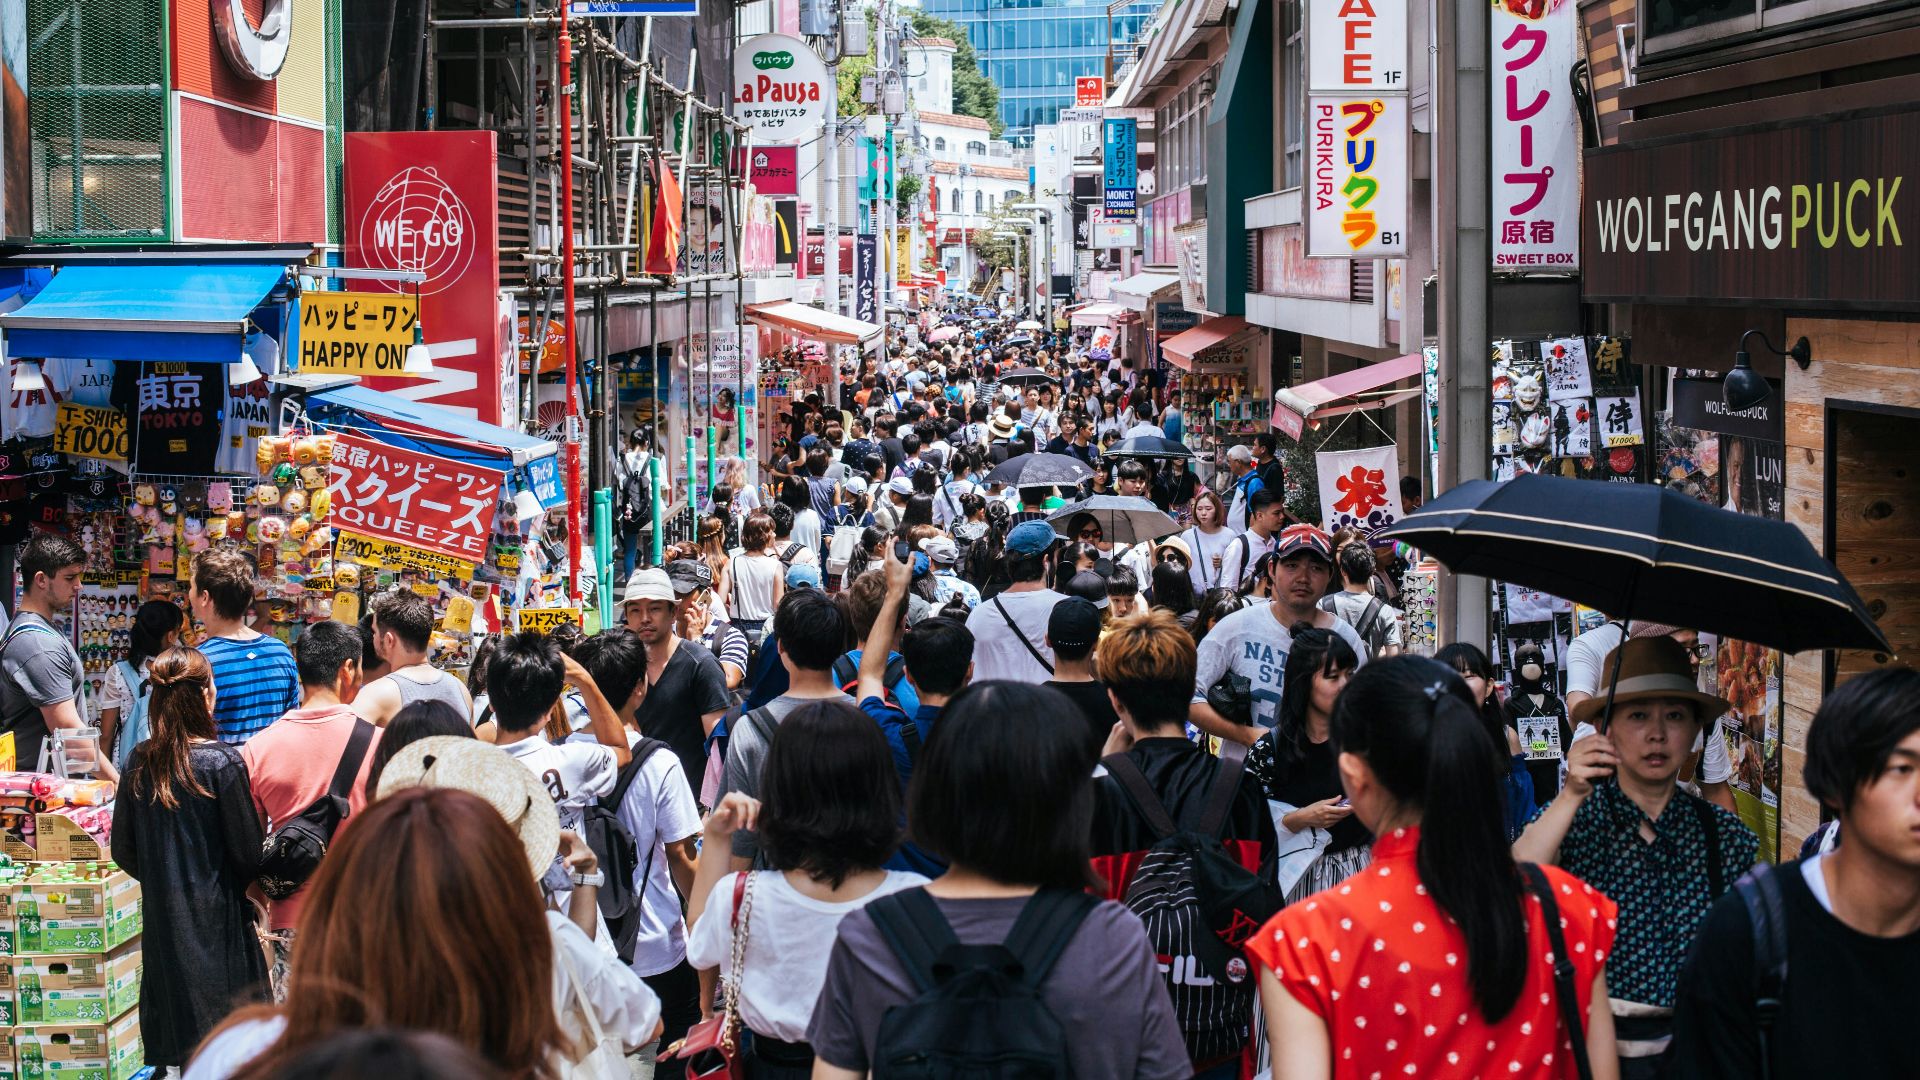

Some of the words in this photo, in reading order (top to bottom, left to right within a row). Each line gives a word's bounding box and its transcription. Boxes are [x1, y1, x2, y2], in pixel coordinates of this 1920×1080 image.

[1384, 71, 1401, 84] 1F
[757, 75, 820, 104] Pausa
[744, 109, 807, 119] ゆであげパスタ
[1502, 24, 1555, 216] クレープ
[756, 158, 767, 166] 6F
[1116, 123, 1126, 186] コインロッカー
[1316, 104, 1334, 211] PURIKURA
[1341, 99, 1384, 249] プリクラ
[1106, 190, 1135, 200] MONEY
[1596, 186, 1782, 253] WOLFGANG
[1791, 176, 1903, 249] PUCK
[1381, 231, 1400, 245] B1
[1501, 220, 1555, 244] 原宿
[1496, 254, 1544, 265] SWEET
[1546, 253, 1575, 264] BOX
[304, 302, 417, 332] ハッピーワン
[302, 341, 368, 368] HAPPY
[1199, 355, 1231, 364] SOCKS
[79, 374, 112, 387] JAP
[136, 372, 203, 412] 東京
[1555, 383, 1579, 391] JAPAN
[142, 411, 203, 429] TOKYO
[230, 401, 270, 423] JAPAN
[1605, 397, 1633, 434] 侍
[1748, 406, 1768, 420] PUCK
[1608, 436, 1635, 446] ¥1000
[330, 443, 497, 497] 原宿ハッピーワン
[1608, 475, 1635, 483] JAPAN
[1755, 455, 1782, 484] LUN
[329, 464, 494, 536] スクイーズ
[1768, 497, 1780, 512] Ser
[327, 502, 486, 553] SQUEEZE
